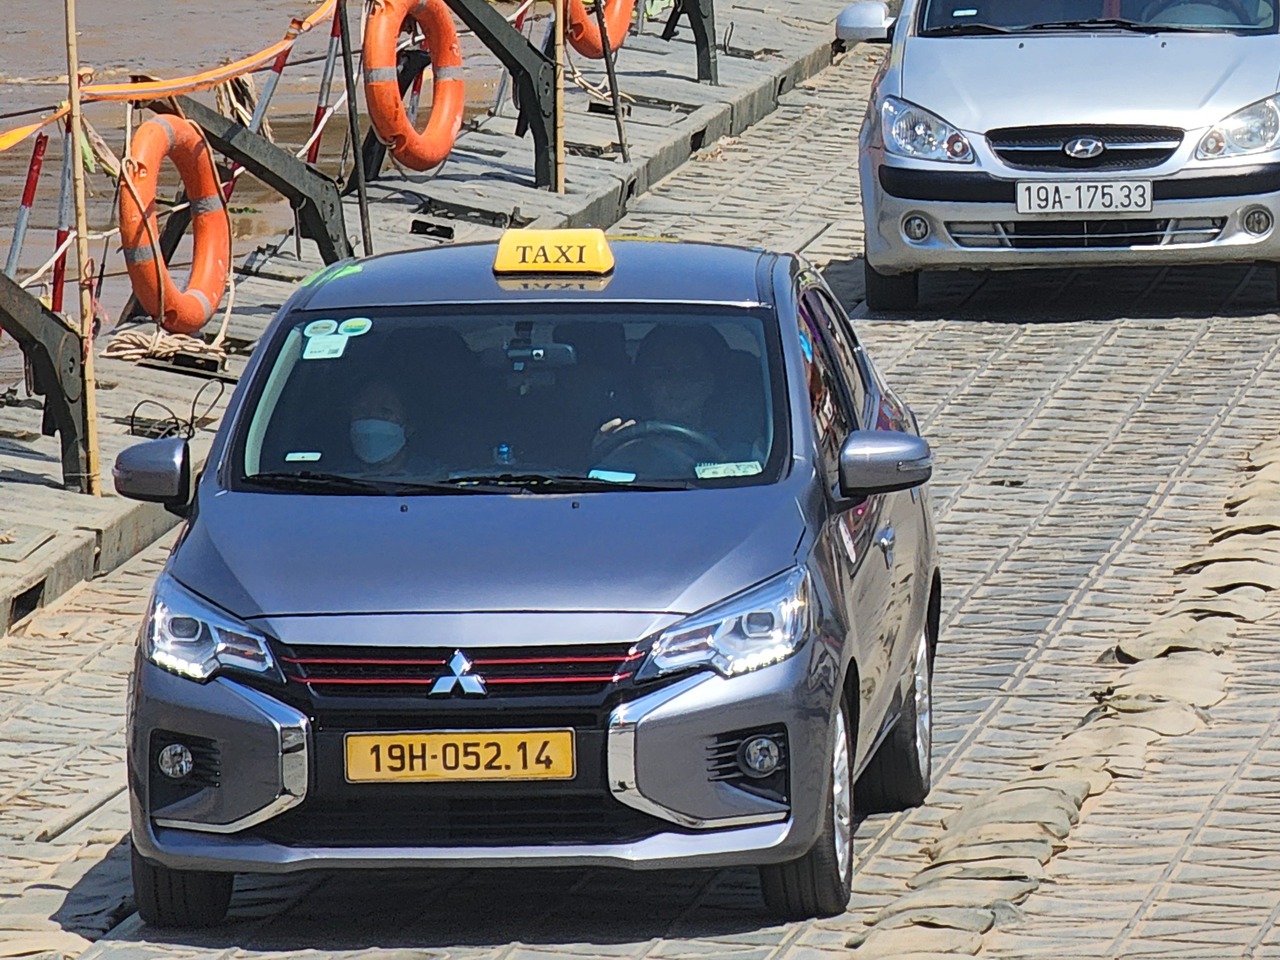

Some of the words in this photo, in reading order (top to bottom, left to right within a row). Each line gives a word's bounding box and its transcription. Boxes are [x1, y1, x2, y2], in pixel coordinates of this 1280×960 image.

[1024, 184, 1147, 210] 19A-175.33
[515, 245, 587, 264] TAXI
[370, 740, 554, 773] 19H-052.14
